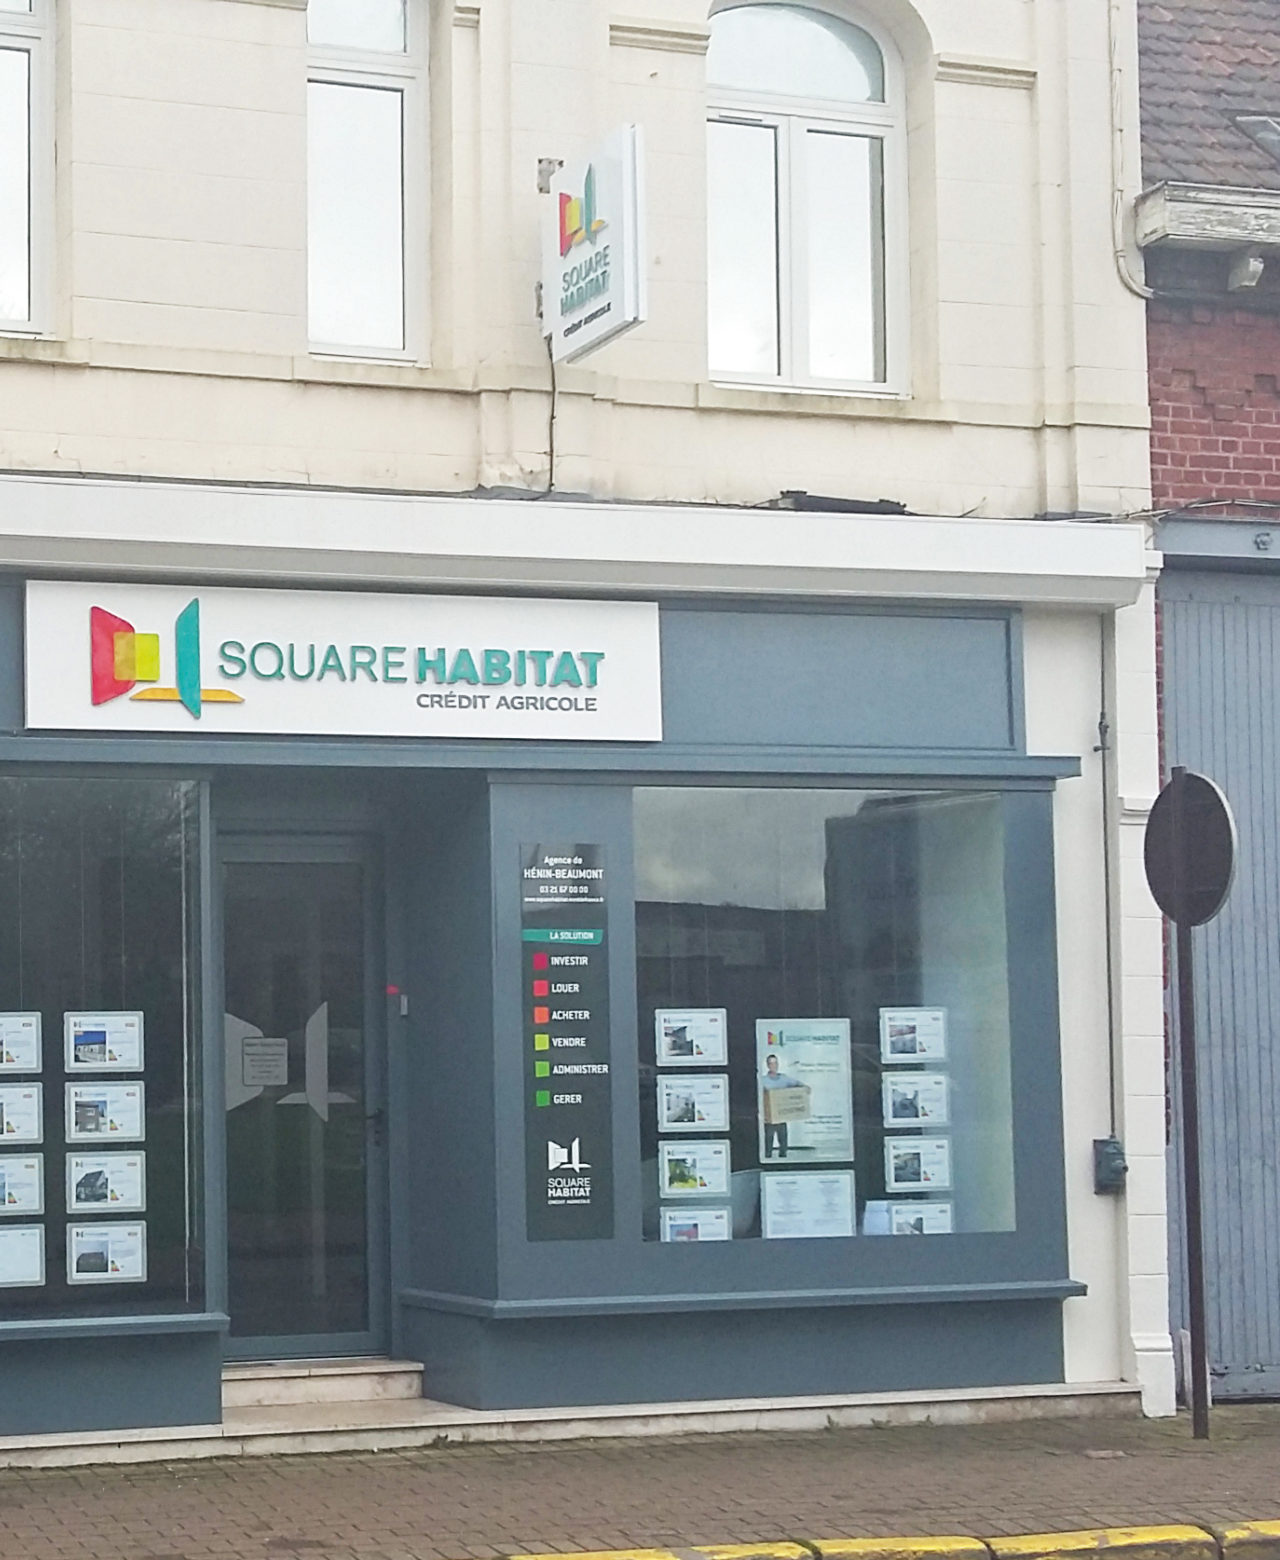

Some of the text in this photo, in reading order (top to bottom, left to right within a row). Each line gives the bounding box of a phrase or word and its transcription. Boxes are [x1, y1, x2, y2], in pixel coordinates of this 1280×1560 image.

[561, 245, 610, 292] SQUARE
[560, 270, 610, 316] HABITAT
[219, 640, 605, 688] SQUARE HABITAT
[416, 691, 598, 712] CRÉDIT AGRICOLE
[544, 856, 583, 866] Agence de
[524, 866, 604, 879] HÉNIN-BEAUMONT
[549, 932, 594, 940] LA SOLUTION
[550, 956, 589, 966] INVESTIR
[551, 983, 580, 993] LOUER
[551, 1010, 591, 1020] ACHETER
[552, 1037, 587, 1047] VENDRE
[552, 1064, 609, 1074] ADMINISTRER
[553, 1094, 582, 1104] GERER
[547, 1177, 591, 1188] SQUARE
[547, 1187, 591, 1197] HABITAT
